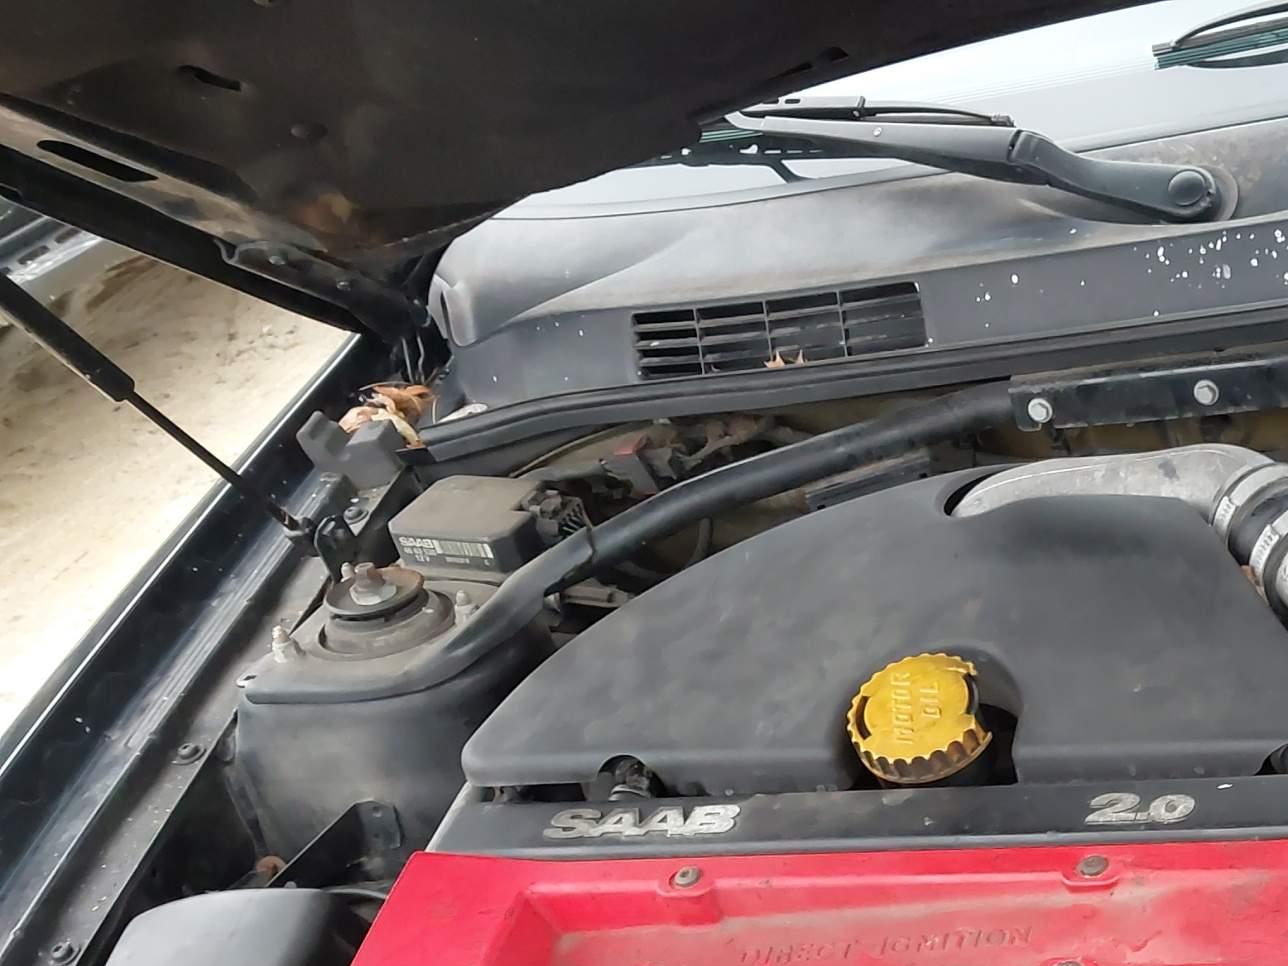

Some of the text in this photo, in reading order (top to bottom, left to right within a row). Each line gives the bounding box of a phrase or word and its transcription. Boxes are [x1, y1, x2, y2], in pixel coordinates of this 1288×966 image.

[890, 672, 914, 745] MOTOR
[919, 681, 942, 719] OIL
[543, 804, 741, 839] SAAB
[1085, 791, 1197, 826] 2.0
[738, 925, 1034, 965] DIRECT IGNITION
